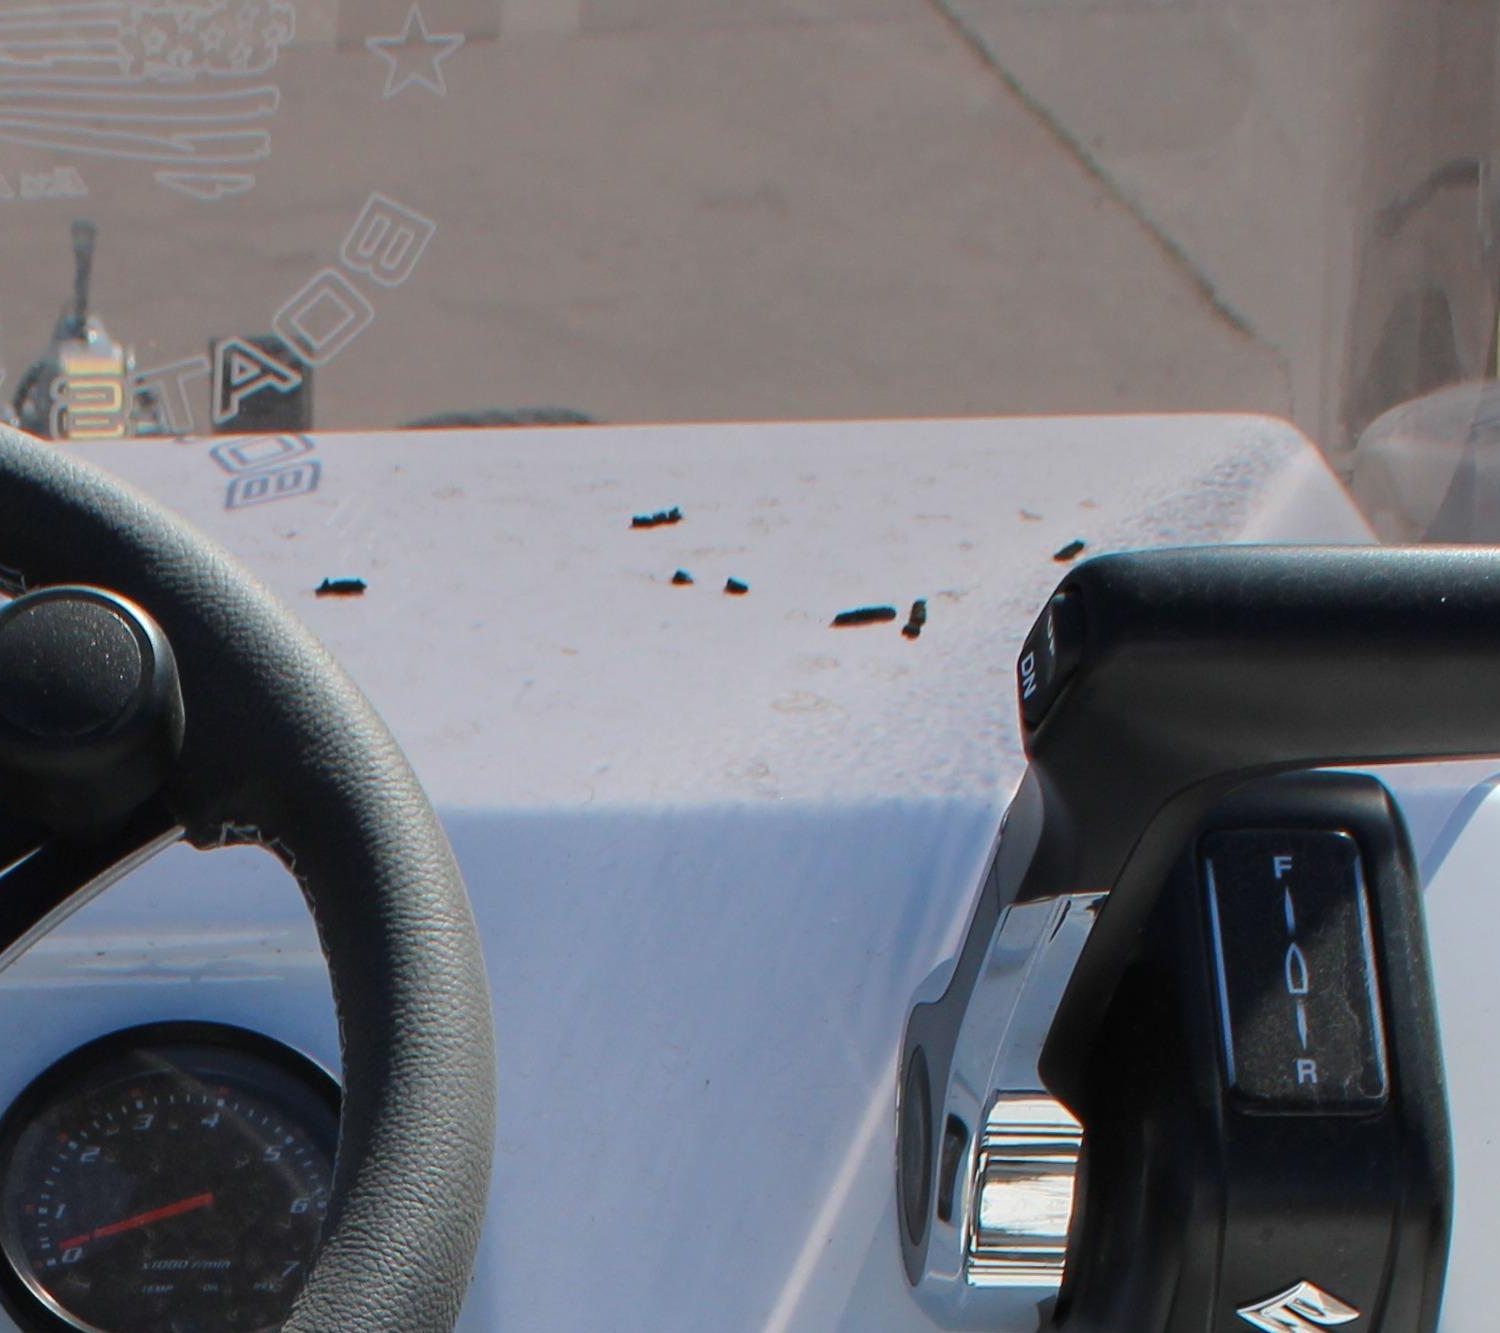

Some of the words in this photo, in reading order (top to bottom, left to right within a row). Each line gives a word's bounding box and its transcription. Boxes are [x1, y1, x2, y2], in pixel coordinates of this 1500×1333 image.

[1020, 650, 1038, 700] DN
[1272, 855, 1294, 879] F
[1297, 1058, 1319, 1084] R
[133, 1113, 155, 1131] 3
[200, 1112, 221, 1129] 4
[80, 1146, 102, 1163] 2
[262, 1145, 282, 1162] 5
[56, 1203, 67, 1220] 1
[289, 1198, 309, 1215] 6
[61, 1246, 84, 1264] 0
[279, 1260, 301, 1278] 7
